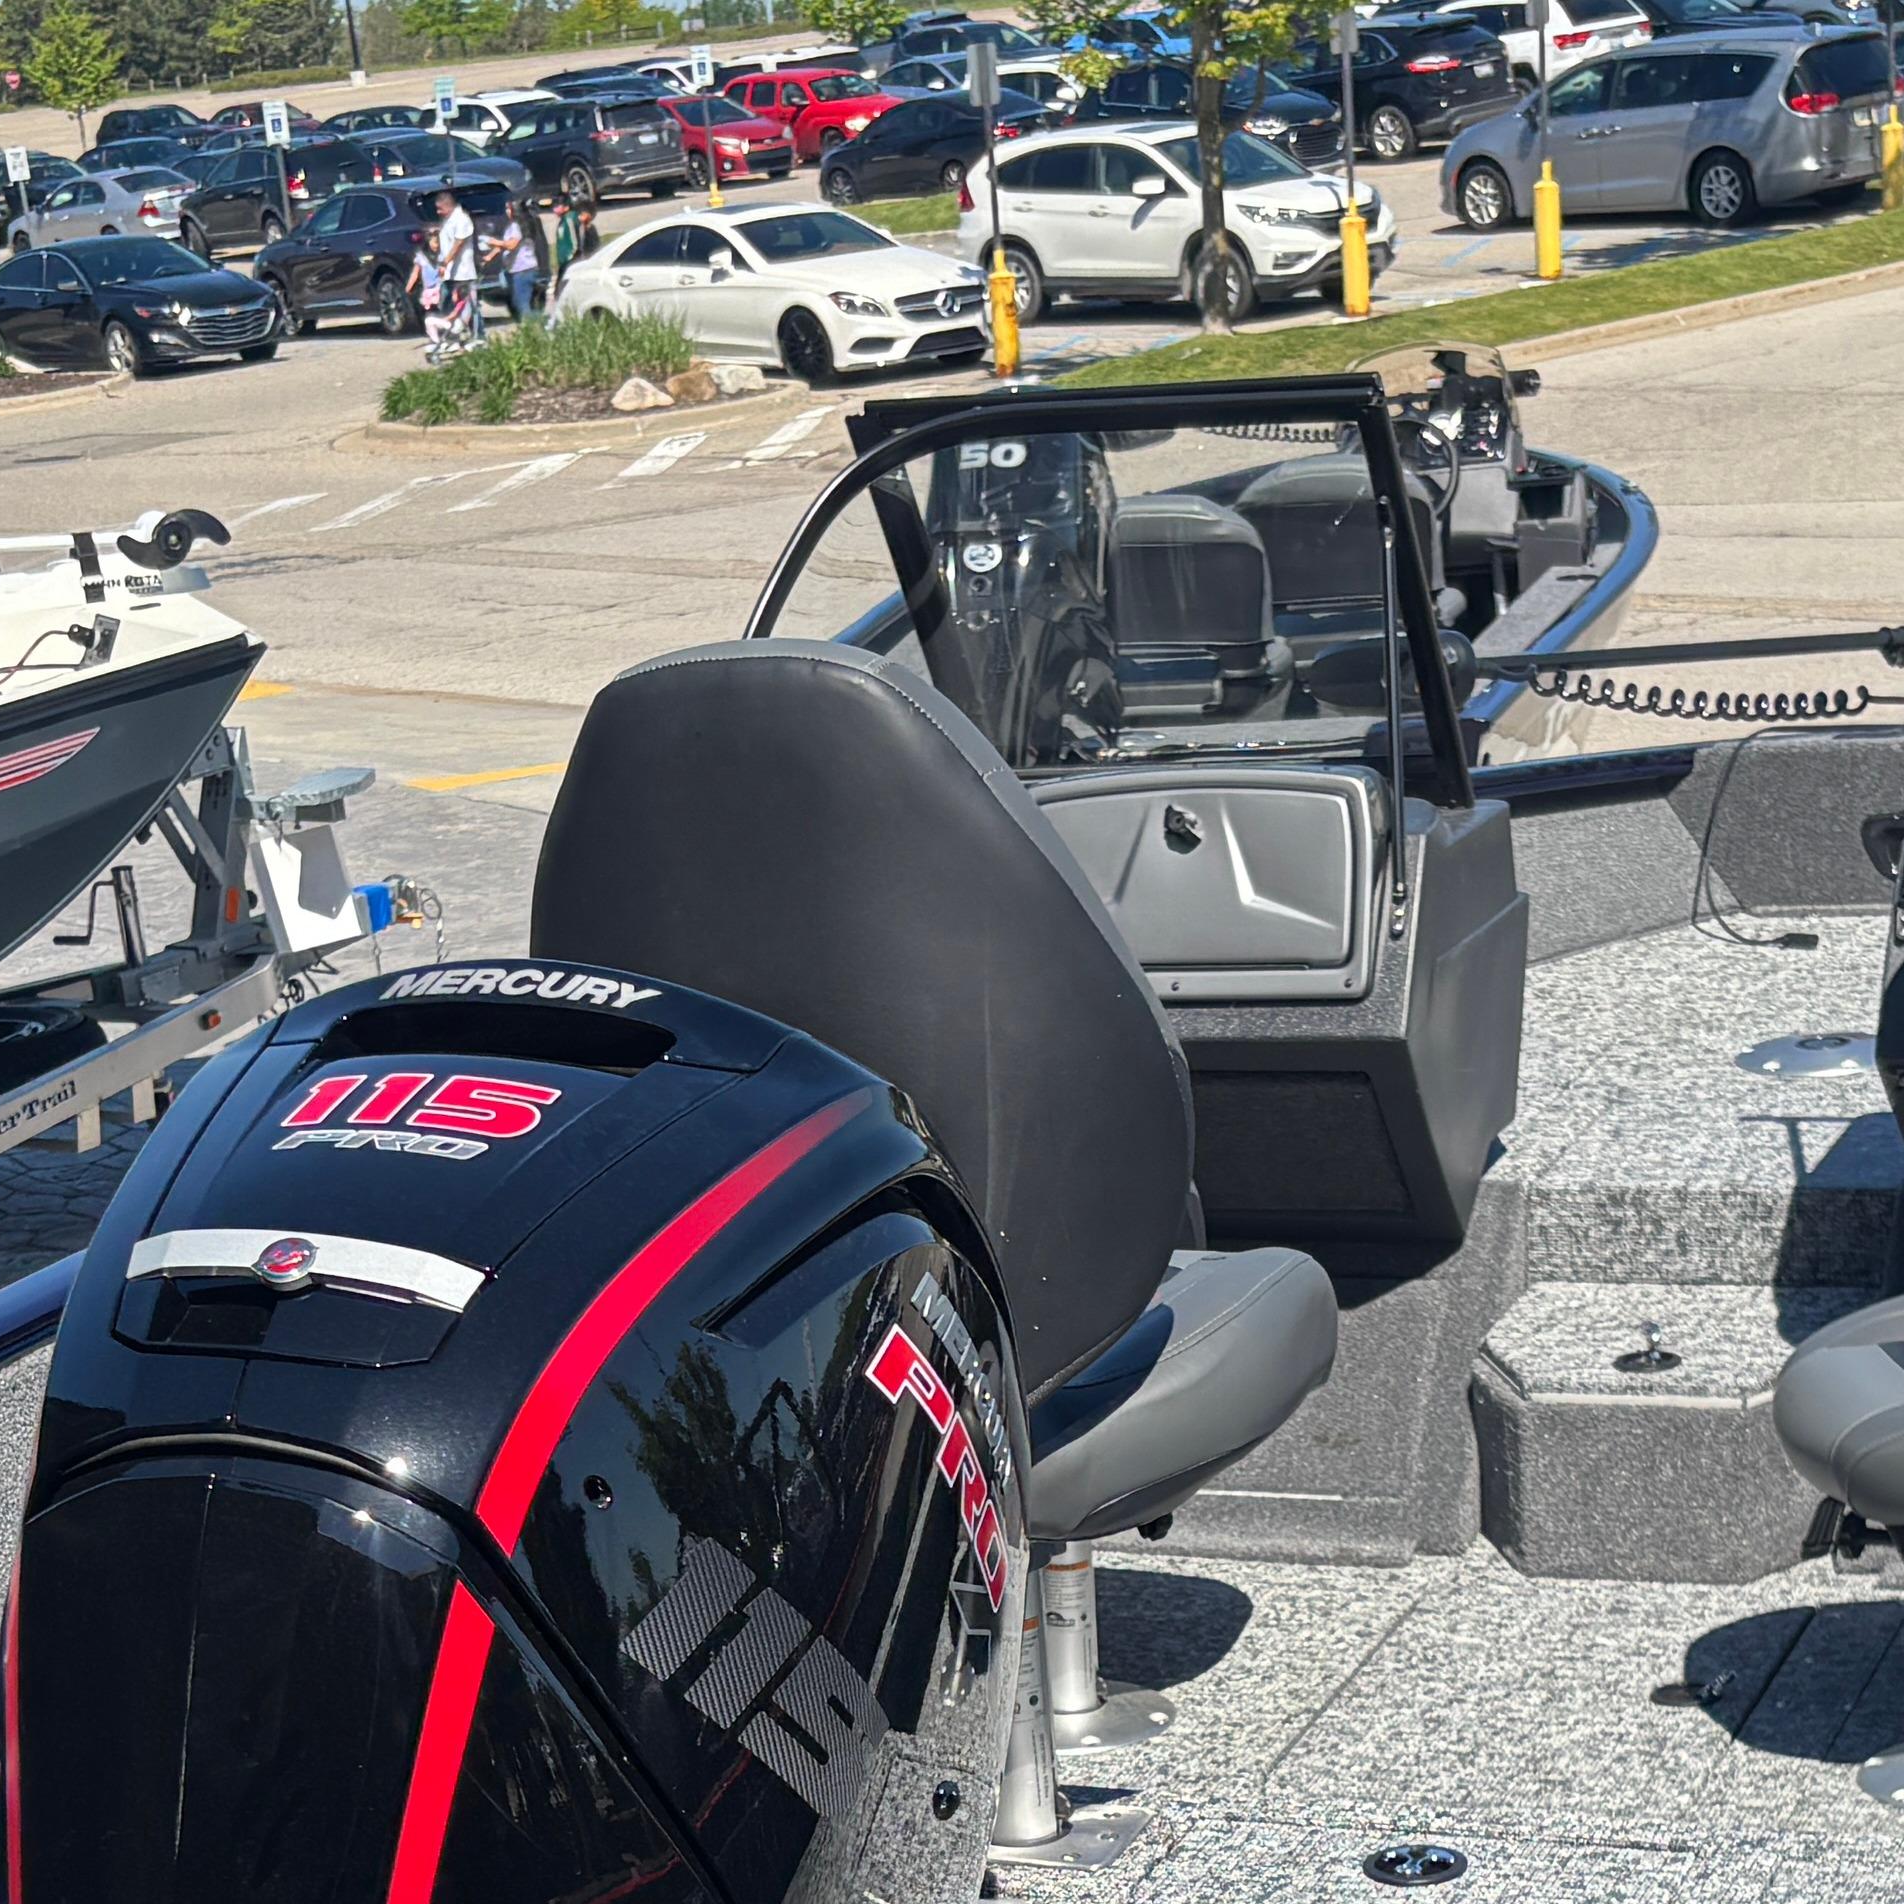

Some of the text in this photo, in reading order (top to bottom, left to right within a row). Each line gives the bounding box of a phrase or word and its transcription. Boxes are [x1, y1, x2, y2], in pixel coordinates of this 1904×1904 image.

[959, 442, 1027, 470] 50
[379, 968, 663, 1009] MERCURY
[22, 1080, 78, 1120] Trail
[280, 1073, 562, 1138] 115
[272, 1130, 489, 1160] PRO
[911, 1271, 1012, 1497] MERCURY
[865, 1323, 1009, 1614] PRO
